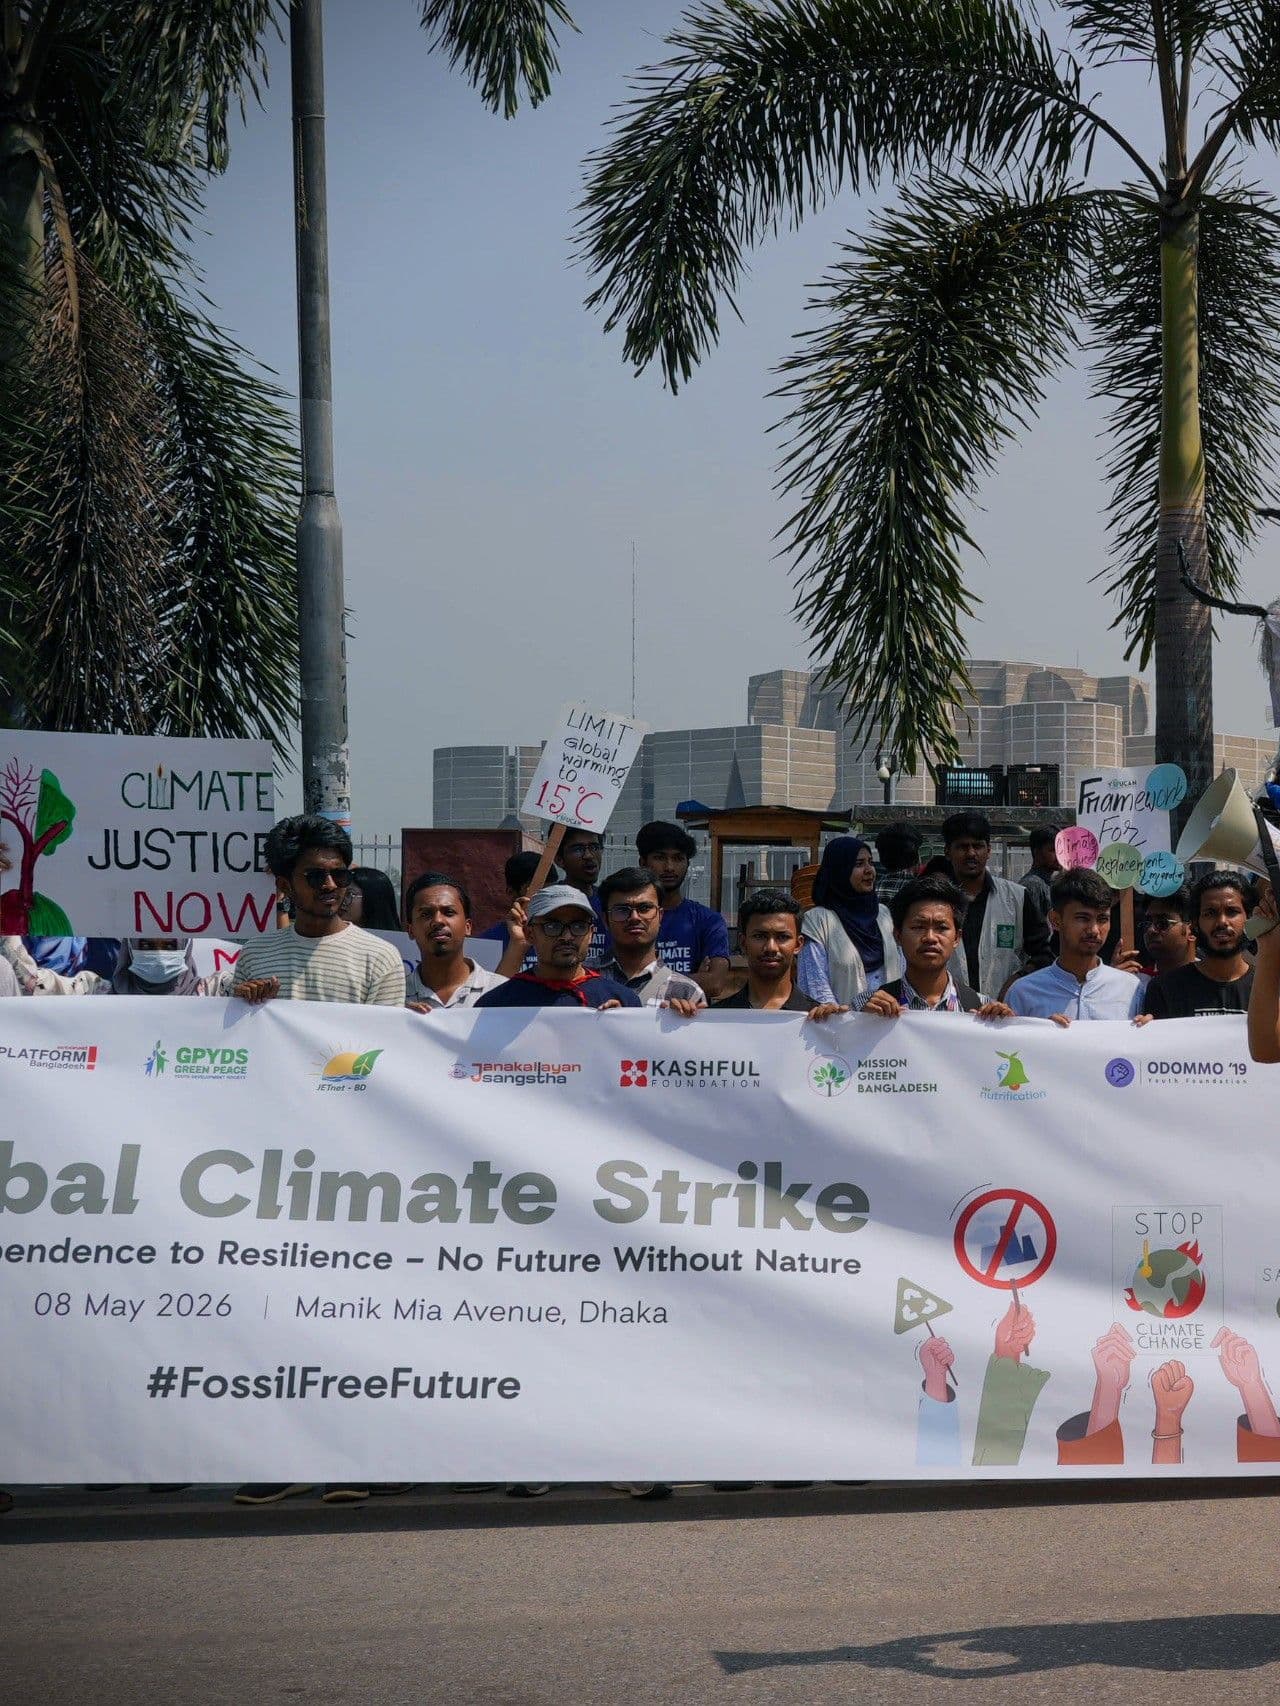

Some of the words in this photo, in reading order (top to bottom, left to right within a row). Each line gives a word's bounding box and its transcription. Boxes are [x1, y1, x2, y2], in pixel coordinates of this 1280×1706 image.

[566, 709, 633, 745] LIMIT
[564, 737, 618, 762] Global
[558, 764, 578, 783] to
[562, 752, 630, 788] warming
[121, 763, 275, 812] CLIMATE
[1078, 777, 1184, 815] Framework
[88, 827, 268, 873] JUSTICE
[134, 890, 277, 934] NOW
[29, 1060, 86, 1070] Bangladesh
[176, 1046, 249, 1065] GPYDS
[858, 1059, 907, 1069] MISSION
[174, 1065, 210, 1074] GREEN
[213, 1066, 248, 1075] PEACE
[651, 1060, 760, 1077] KASHFUL
[858, 1071, 897, 1081] GREEN
[1147, 1061, 1224, 1075] ODOMMO
[354, 1083, 367, 1092] BD
[482, 1073, 567, 1086] sangstha
[651, 1079, 760, 1088] FOUNDATION
[858, 1083, 938, 1094] BANGLADESH
[180, 1148, 557, 1224] Climate
[592, 1159, 871, 1234] Strike
[1135, 1211, 1204, 1236] STOP
[171, 1241, 205, 1266] to
[218, 1240, 393, 1270] Resilience
[438, 1246, 484, 1272] No
[498, 1247, 601, 1273] Future
[613, 1246, 743, 1272] Without
[755, 1248, 862, 1275] Nature
[34, 1292, 72, 1318] 08
[84, 1293, 145, 1322] May
[156, 1293, 233, 1318] 2026
[295, 1295, 382, 1320] Manik
[394, 1296, 442, 1321] Mia
[453, 1299, 567, 1326] Avenue,
[580, 1300, 669, 1324] Dhaka
[1136, 1323, 1205, 1338] CLIMATE
[1137, 1335, 1203, 1351] CHANGE
[146, 1365, 522, 1401] #FossilFreeFuture
